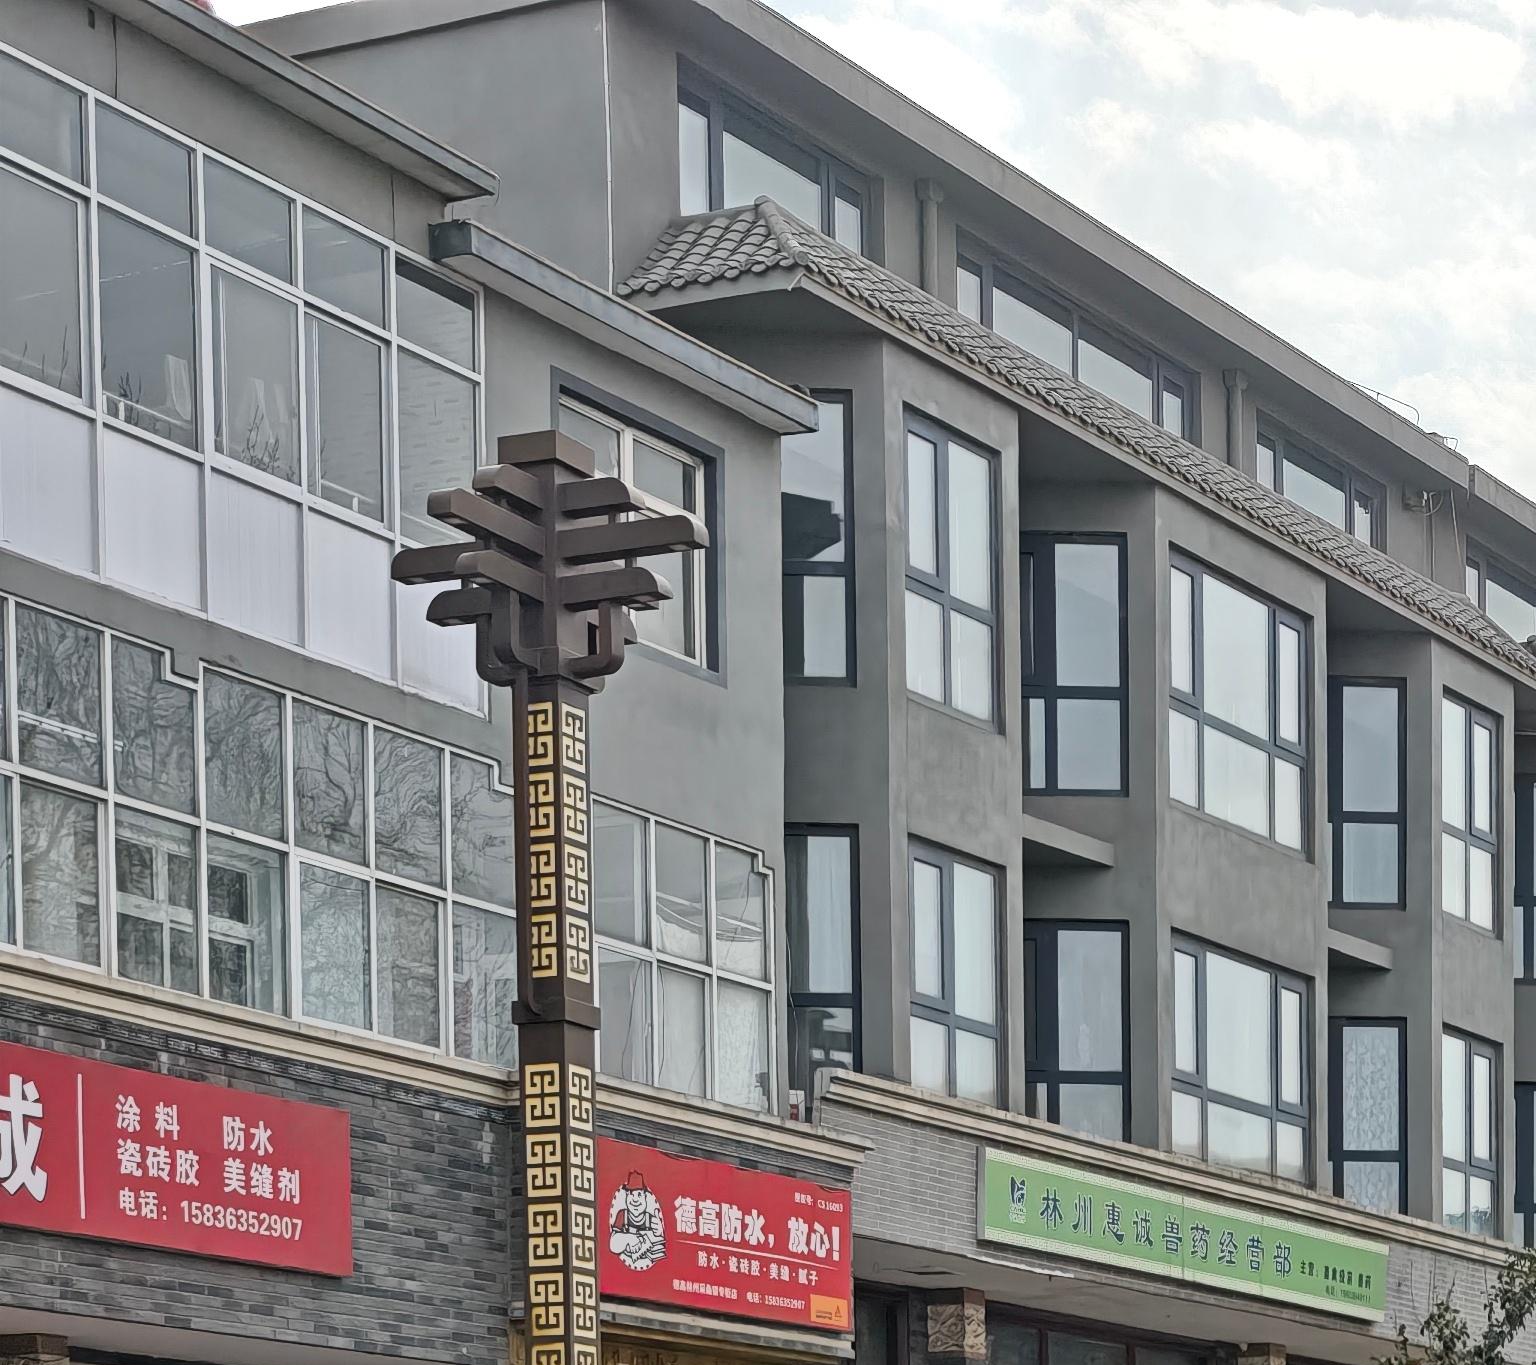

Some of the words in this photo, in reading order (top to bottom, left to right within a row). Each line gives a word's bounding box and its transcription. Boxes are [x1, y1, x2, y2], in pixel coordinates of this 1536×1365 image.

[114, 1093, 181, 1141] 涂料
[222, 1115, 274, 1157] 防水
[115, 1137, 201, 1187] 瓷砖胶
[223, 1157, 301, 1205] 美缝剂
[180, 1199, 303, 1242] 15836352907
[1039, 1187, 1293, 1279] 林州惠诚兽药经营部
